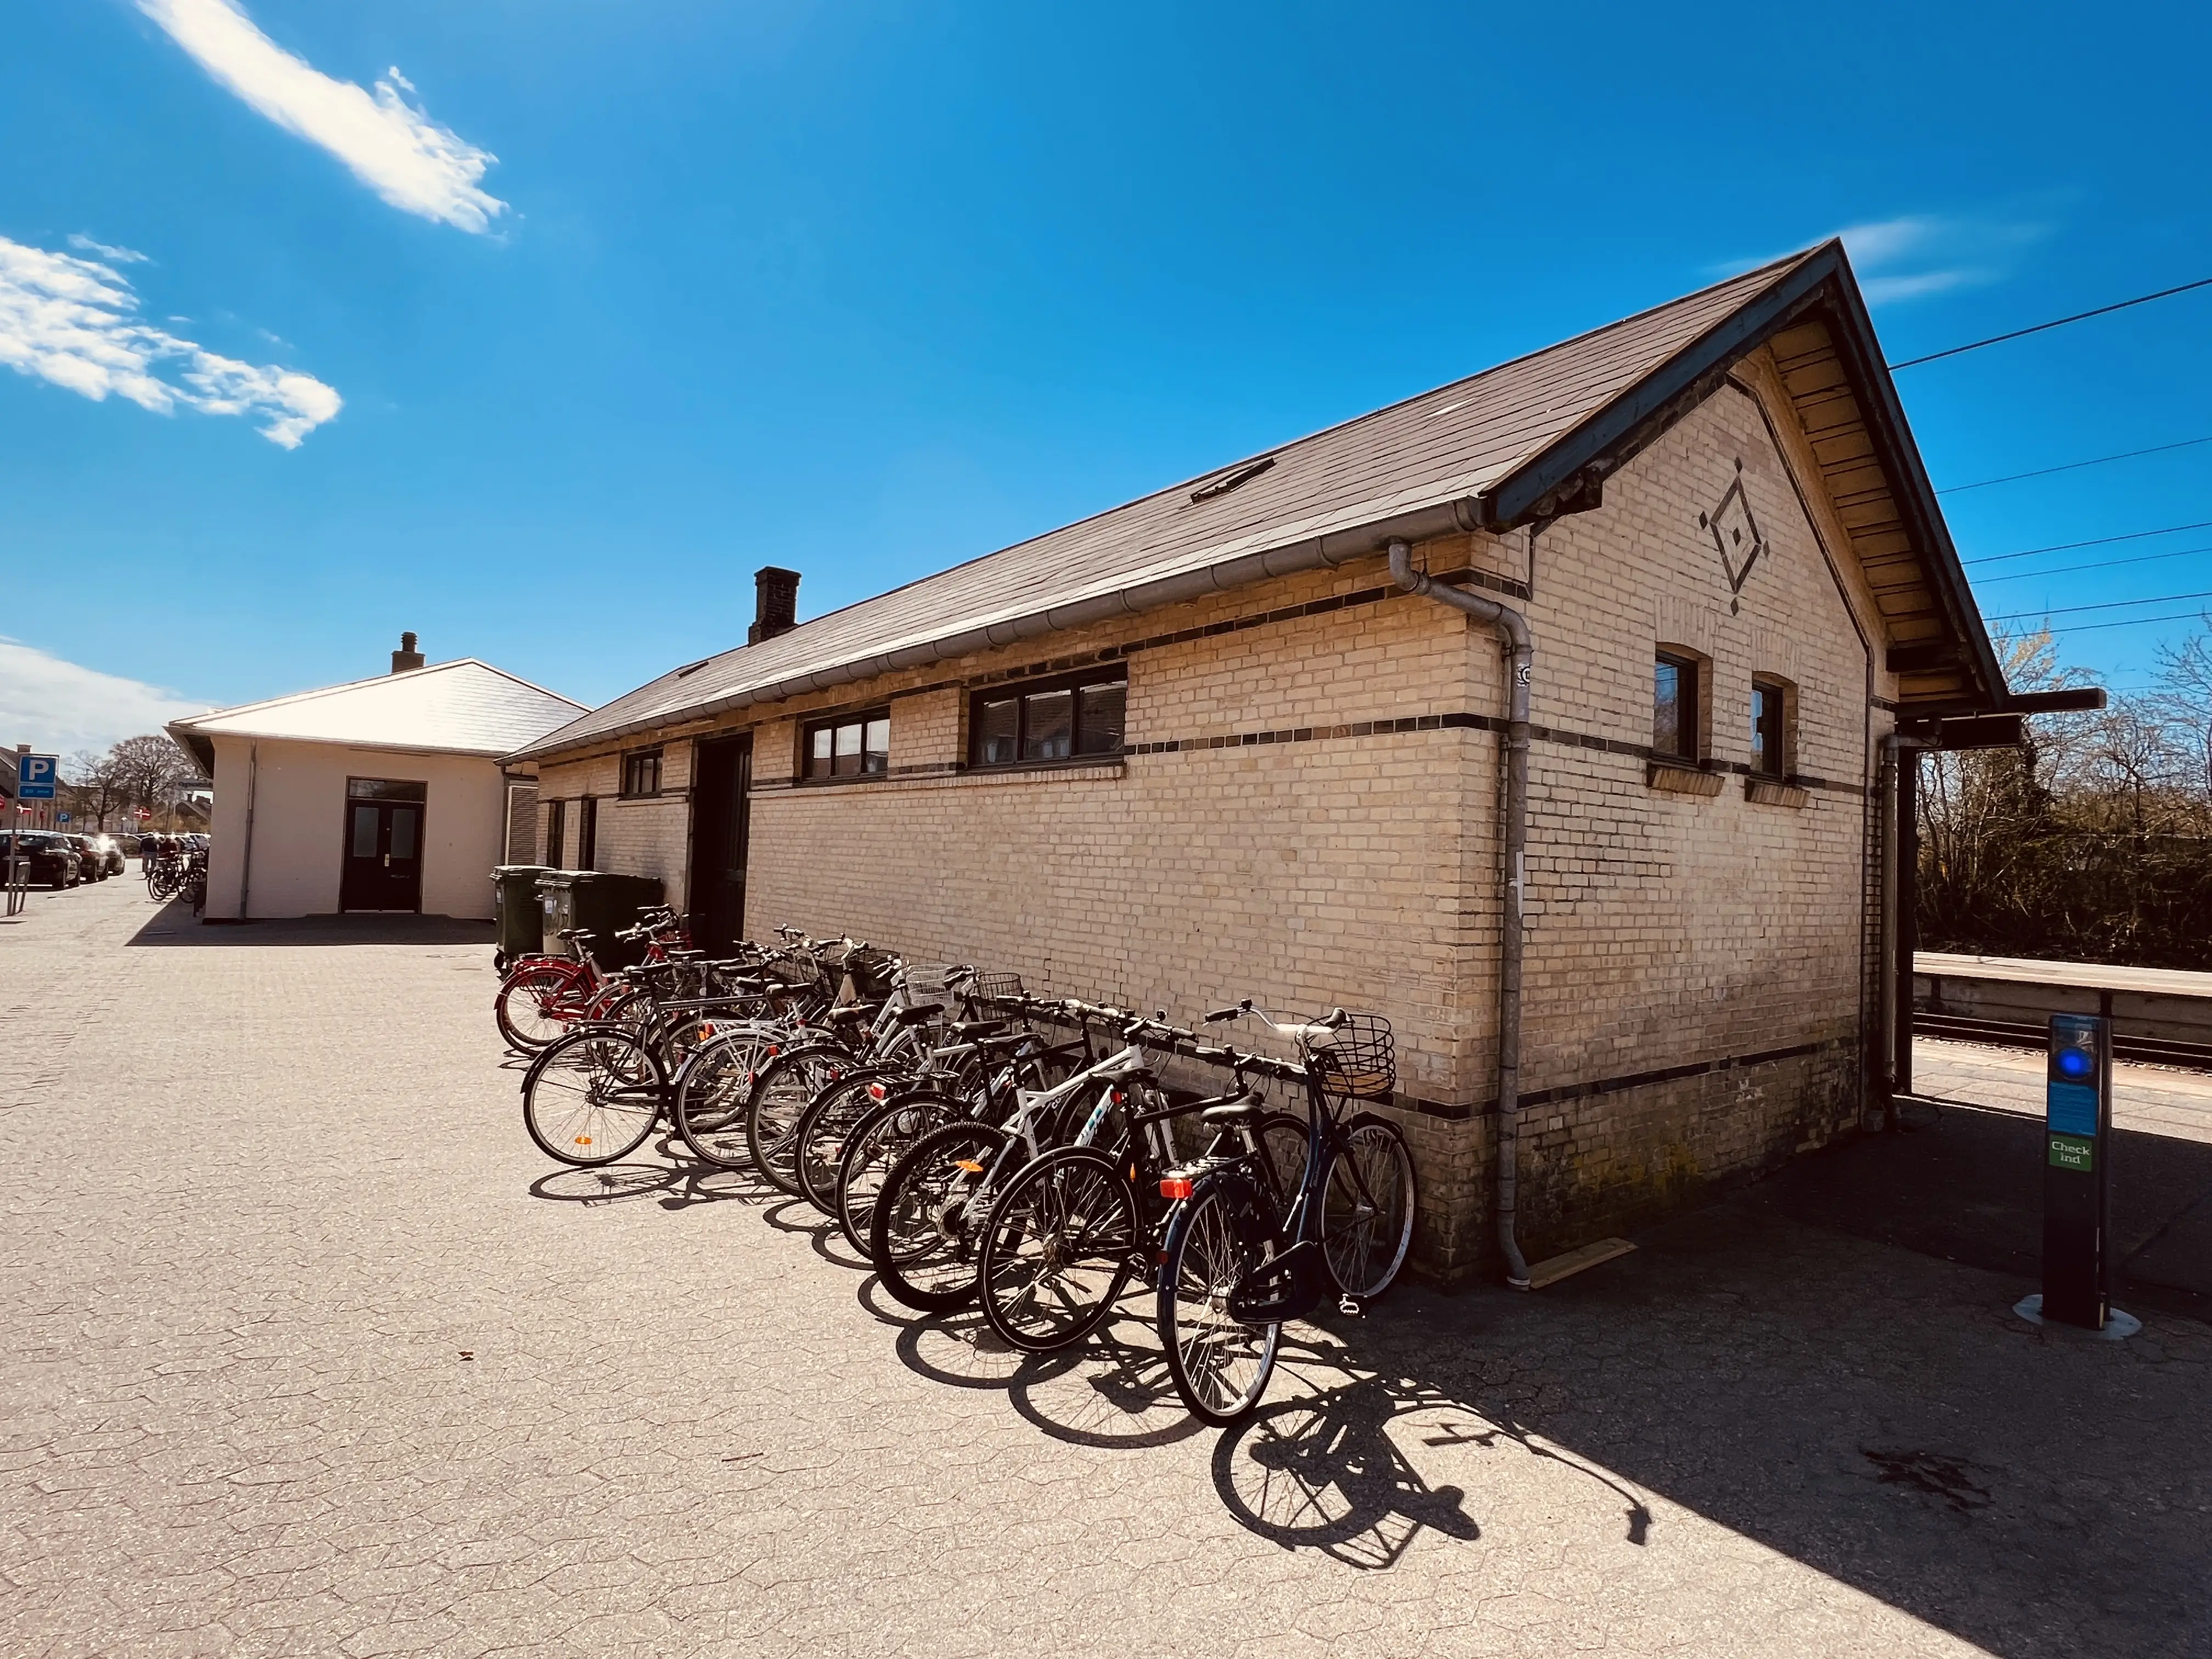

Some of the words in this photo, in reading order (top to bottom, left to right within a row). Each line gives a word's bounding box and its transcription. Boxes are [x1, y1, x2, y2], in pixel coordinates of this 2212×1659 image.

[29, 760, 49, 780] P
[60, 814, 68, 822] P
[2052, 1141, 2090, 1155] Check
